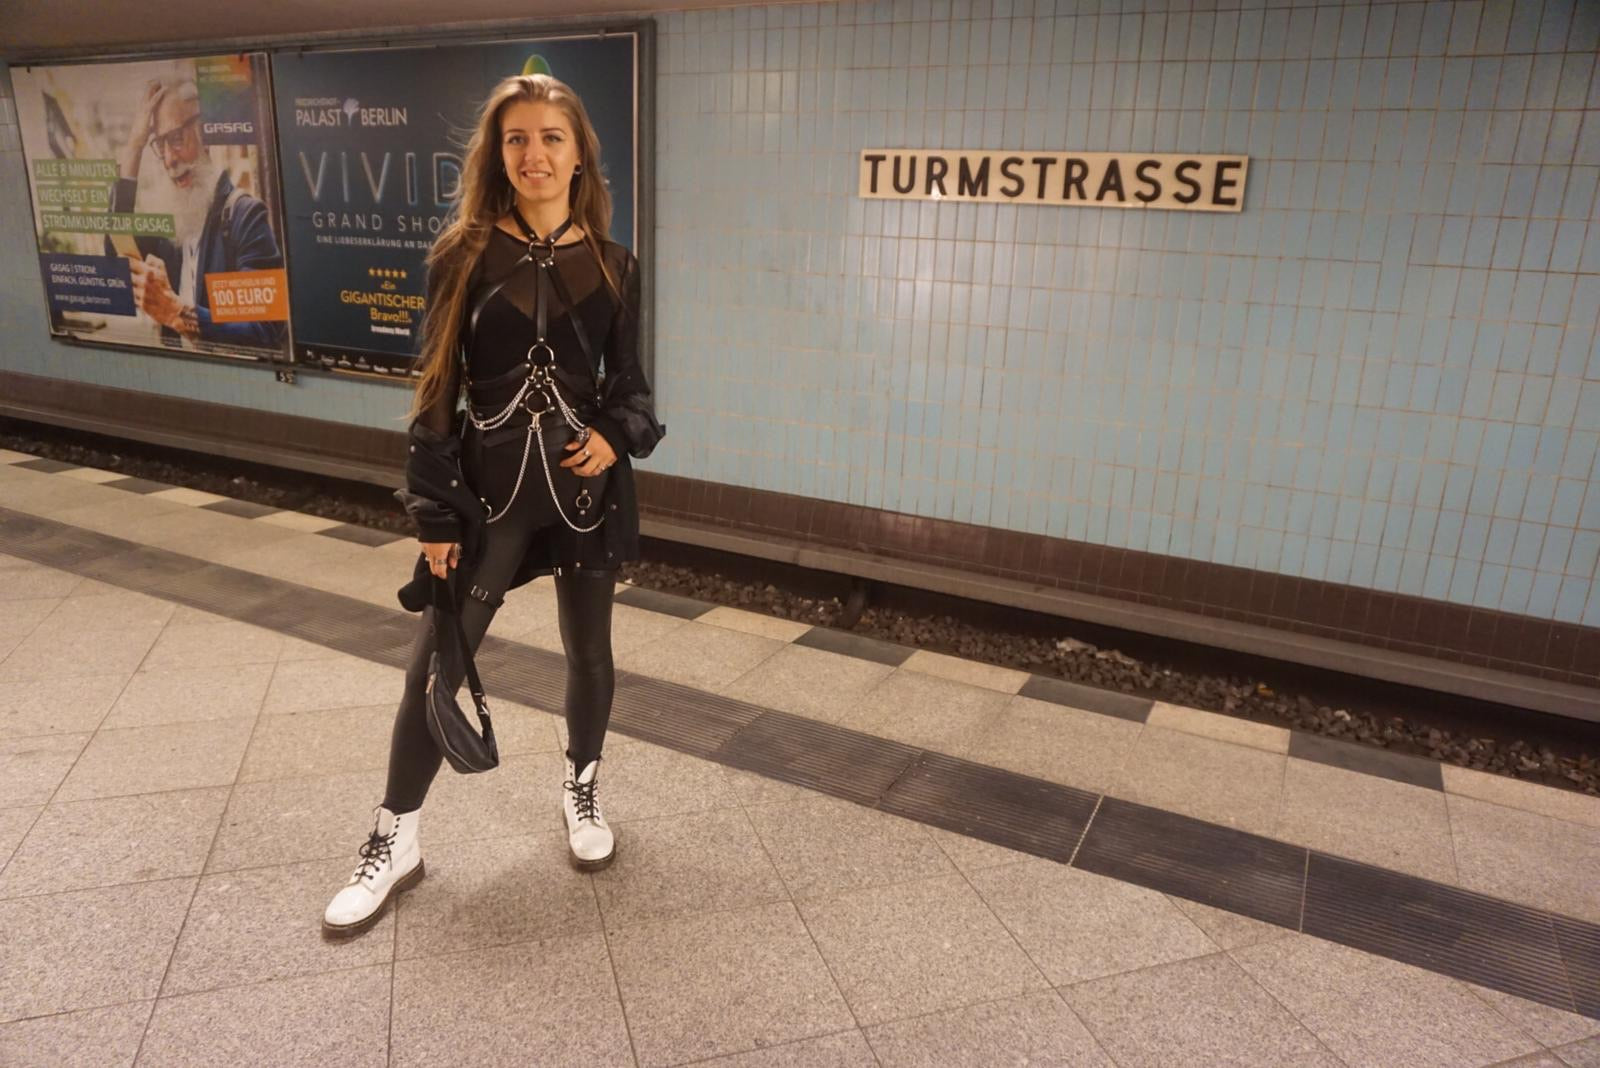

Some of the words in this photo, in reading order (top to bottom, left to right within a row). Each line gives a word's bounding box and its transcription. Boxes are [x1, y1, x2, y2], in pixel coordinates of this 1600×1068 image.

[296, 108, 341, 126] PALAST
[360, 108, 408, 126] BERLIN
[203, 122, 254, 133] GASAG
[36, 163, 57, 176] ALLE
[68, 163, 117, 177] MINUTEN
[299, 151, 463, 208] VIVID
[863, 153, 1243, 206] TURMSTRASSE
[39, 188, 88, 202] WECHSELT
[90, 189, 108, 203] EIN
[43, 214, 111, 230] STROMKUNDE
[112, 217, 132, 231] ZUR
[134, 217, 174, 233] GASAG.
[312, 211, 383, 231] GRAND
[212, 289, 234, 306] 100
[340, 290, 426, 310] GIGANTISCHER
